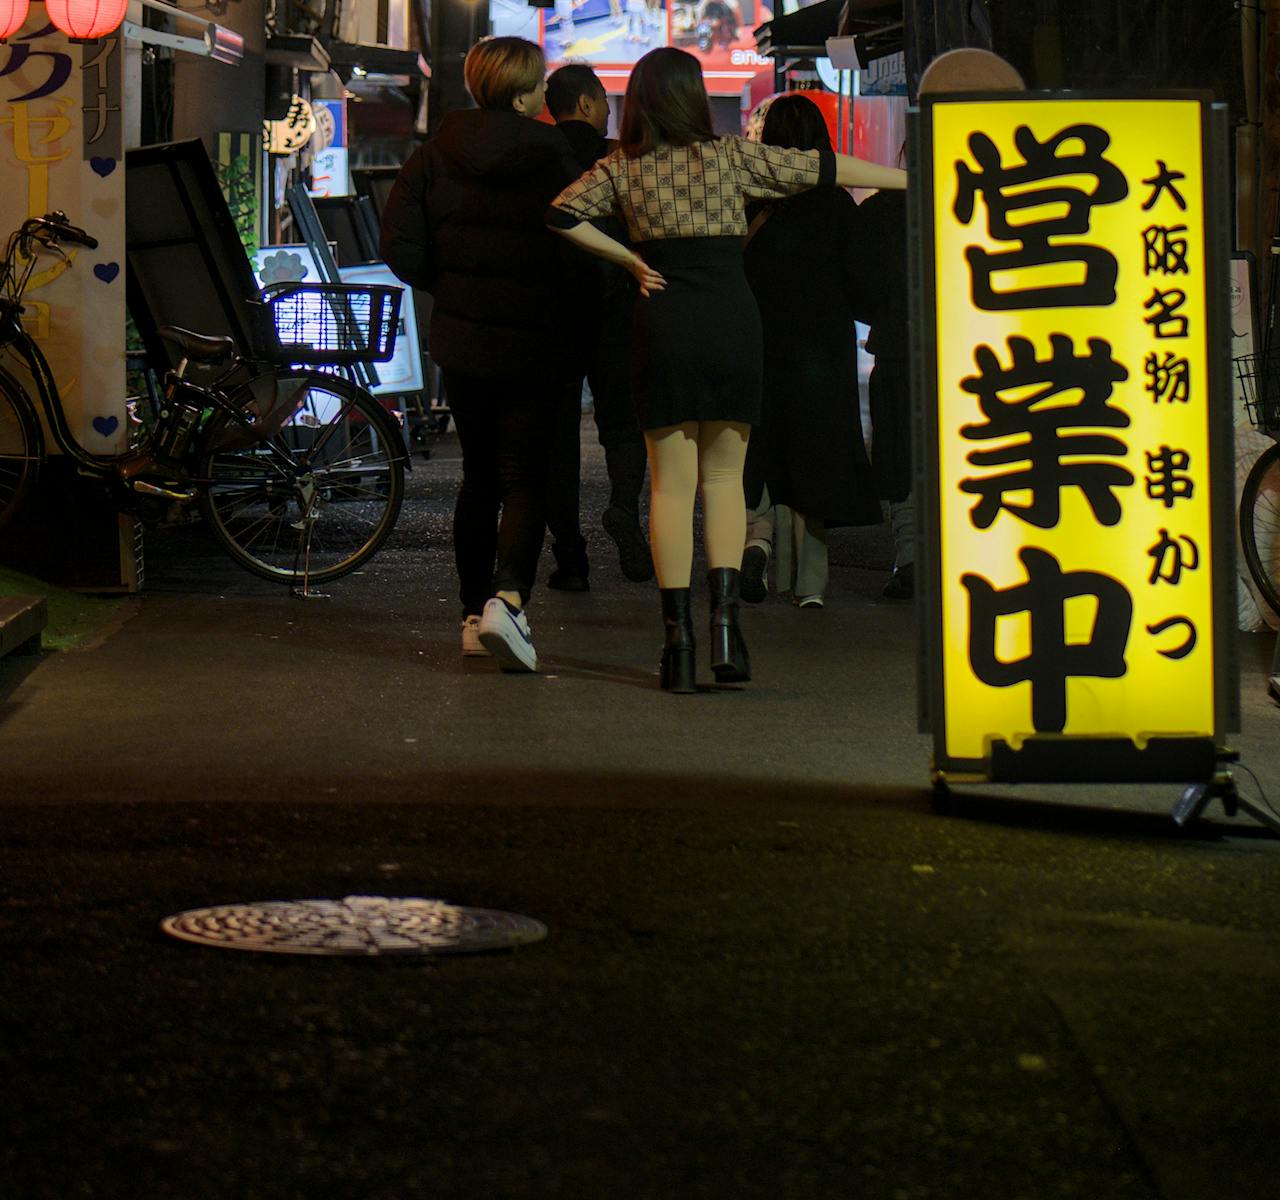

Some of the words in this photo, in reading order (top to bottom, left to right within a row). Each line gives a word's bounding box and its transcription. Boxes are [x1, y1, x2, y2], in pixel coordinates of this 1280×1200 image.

[1140, 158, 1192, 405] 大阪名物
[953, 121, 1134, 736] 営業中
[1143, 446, 1200, 661] 串かつ
